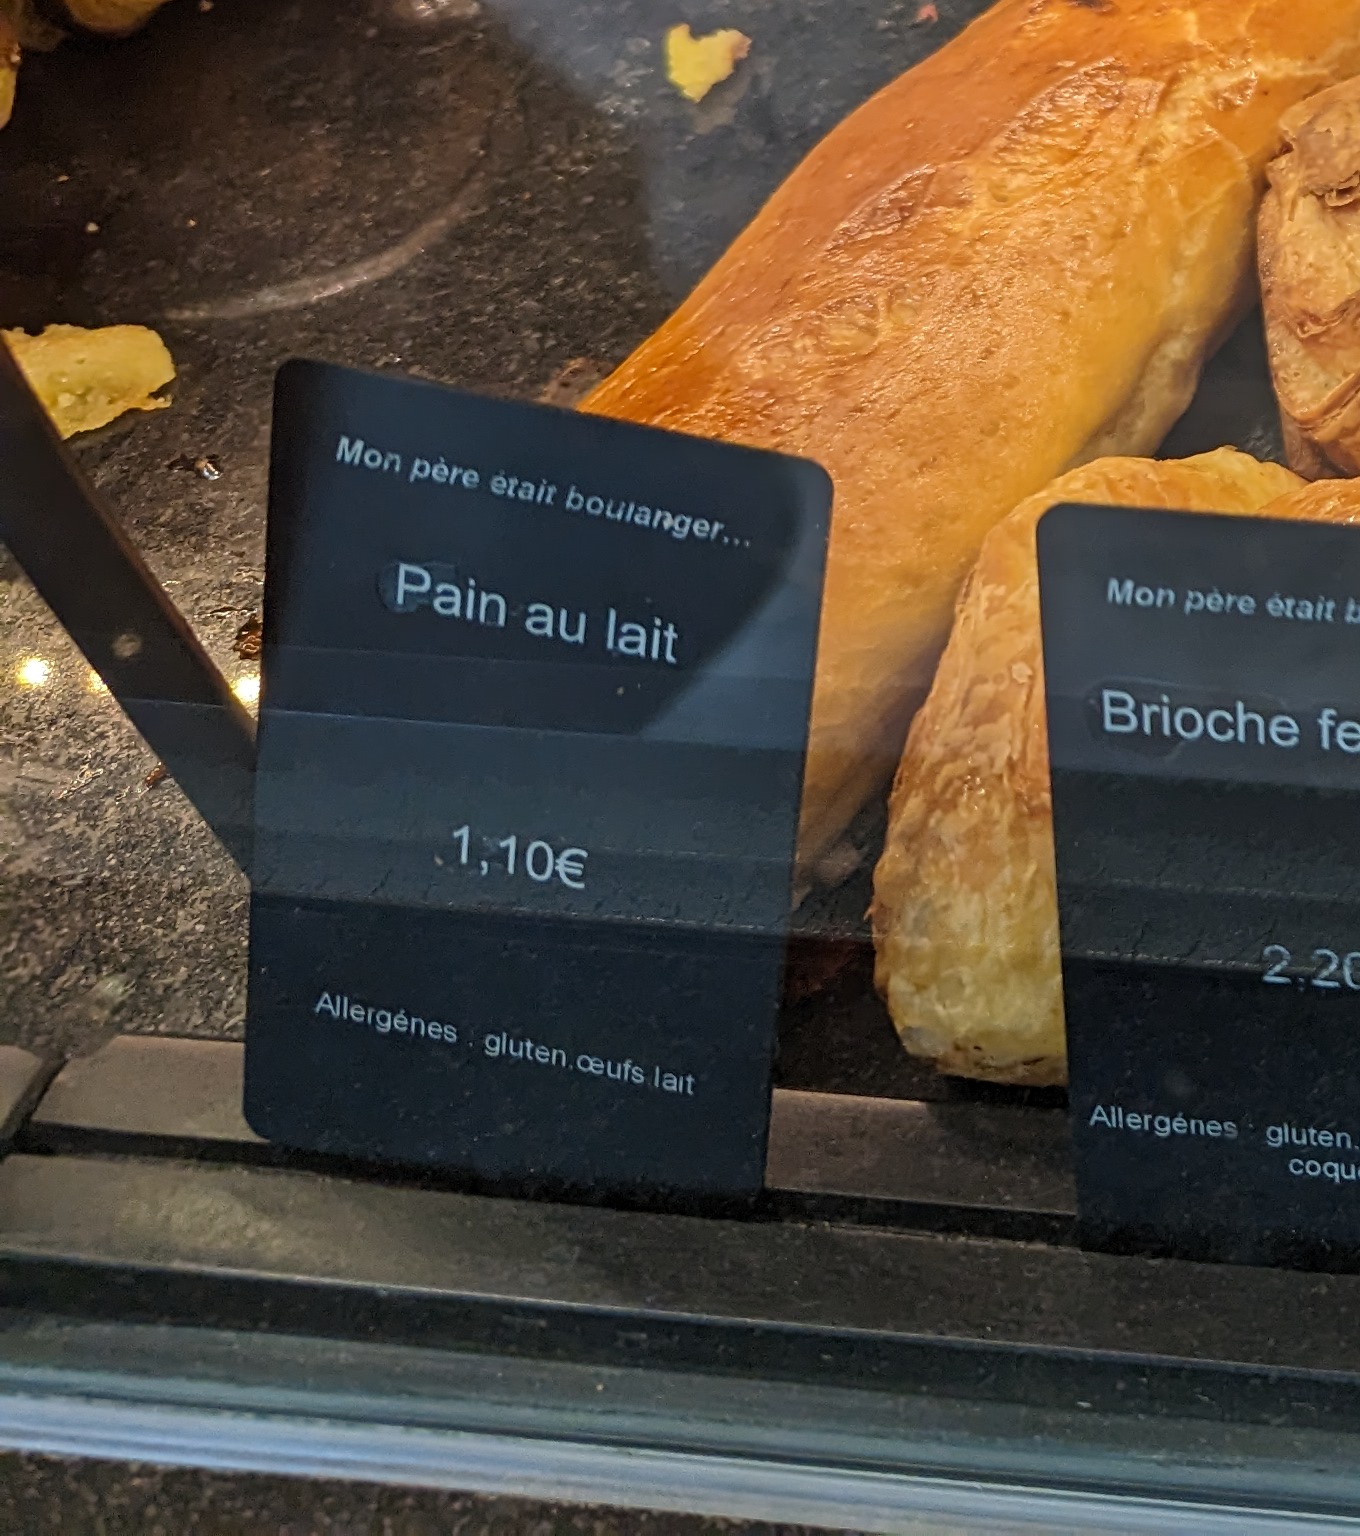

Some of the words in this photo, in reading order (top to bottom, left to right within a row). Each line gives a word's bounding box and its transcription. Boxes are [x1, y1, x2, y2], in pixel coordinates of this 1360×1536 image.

[336, 436, 400, 472] Mon
[410, 457, 480, 490] père
[490, 470, 557, 506] était
[396, 563, 507, 627] Pain
[525, 601, 587, 645] au
[606, 608, 679, 664] lait
[1107, 578, 1175, 609] Mon
[1184, 587, 1256, 615] père
[1265, 592, 1336, 623] était
[1101, 689, 1300, 748] Brioche
[453, 824, 589, 889] 1,10€
